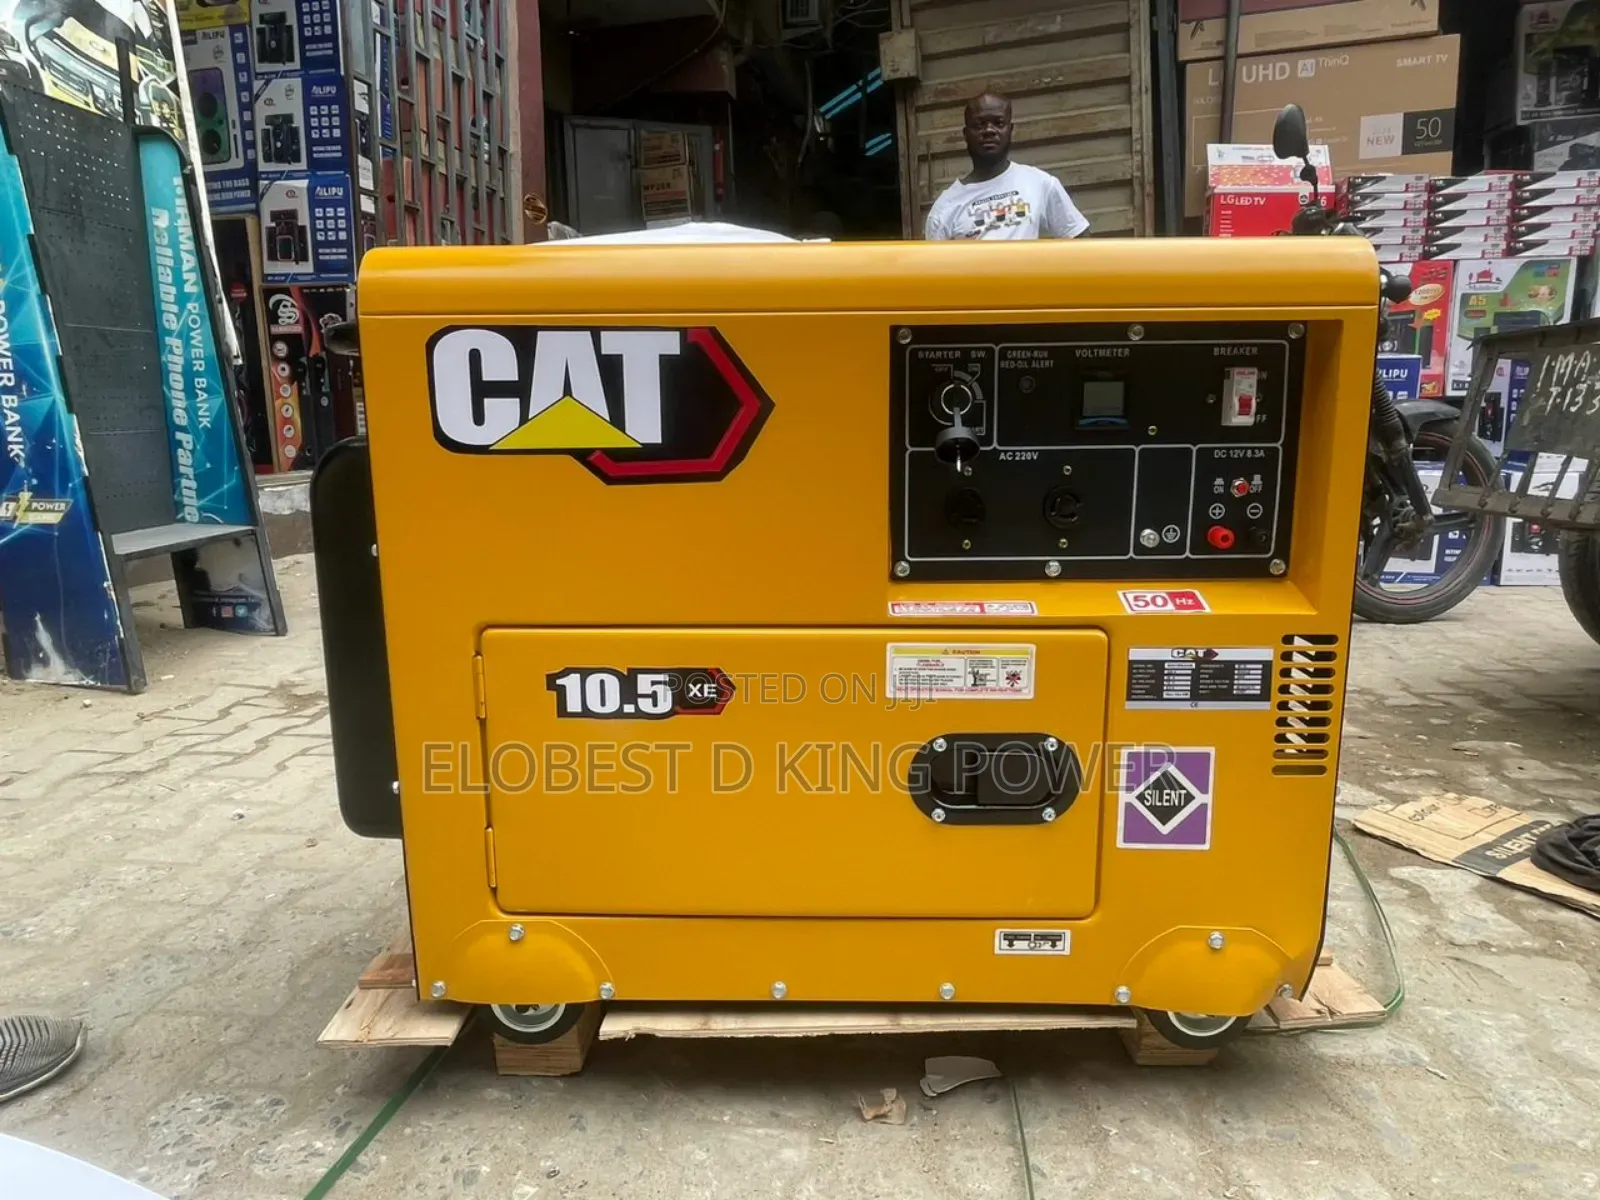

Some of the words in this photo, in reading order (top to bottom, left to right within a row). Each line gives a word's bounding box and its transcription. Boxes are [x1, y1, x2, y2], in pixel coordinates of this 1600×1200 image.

[1396, 56, 1432, 68] SMART
[1435, 53, 1449, 64] TV
[1242, 62, 1291, 85] UHD
[1318, 54, 1350, 67] ThinQ
[1416, 116, 1442, 141] 50
[1366, 135, 1396, 147] NEW
[1220, 195, 1235, 204] LG
[1235, 197, 1252, 205] LED
[1253, 197, 1266, 205] TV
[186, 303, 205, 371] POWER
[918, 350, 961, 359] STARTER
[1006, 350, 1049, 359] GREEN-RUN
[1075, 347, 1131, 358] VOLTMETER
[1213, 347, 1259, 356] BREAKER
[1030, 360, 1054, 368] ALERT
[165, 337, 190, 426] Phone
[432, 328, 681, 446] CAT
[194, 378, 211, 429] BANK
[1256, 414, 1268, 423] FF
[1, 396, 25, 460] BANK
[999, 451, 1013, 461] AC
[1014, 450, 1039, 461] 220V
[1214, 450, 1227, 459] DC
[1229, 450, 1245, 459] 12V
[1246, 450, 1265, 458] 8.3A
[1213, 486, 1224, 494] ON
[1249, 485, 1263, 494] OFF
[31, 502, 66, 511] POWER
[1132, 594, 1168, 608] 50
[1175, 597, 1195, 606] Hz
[1171, 648, 1207, 659] CAT
[556, 673, 674, 715] 10.5
[688, 683, 717, 698] XE
[1143, 789, 1187, 807] SILENT
[1486, 832, 1538, 860] SILENT
